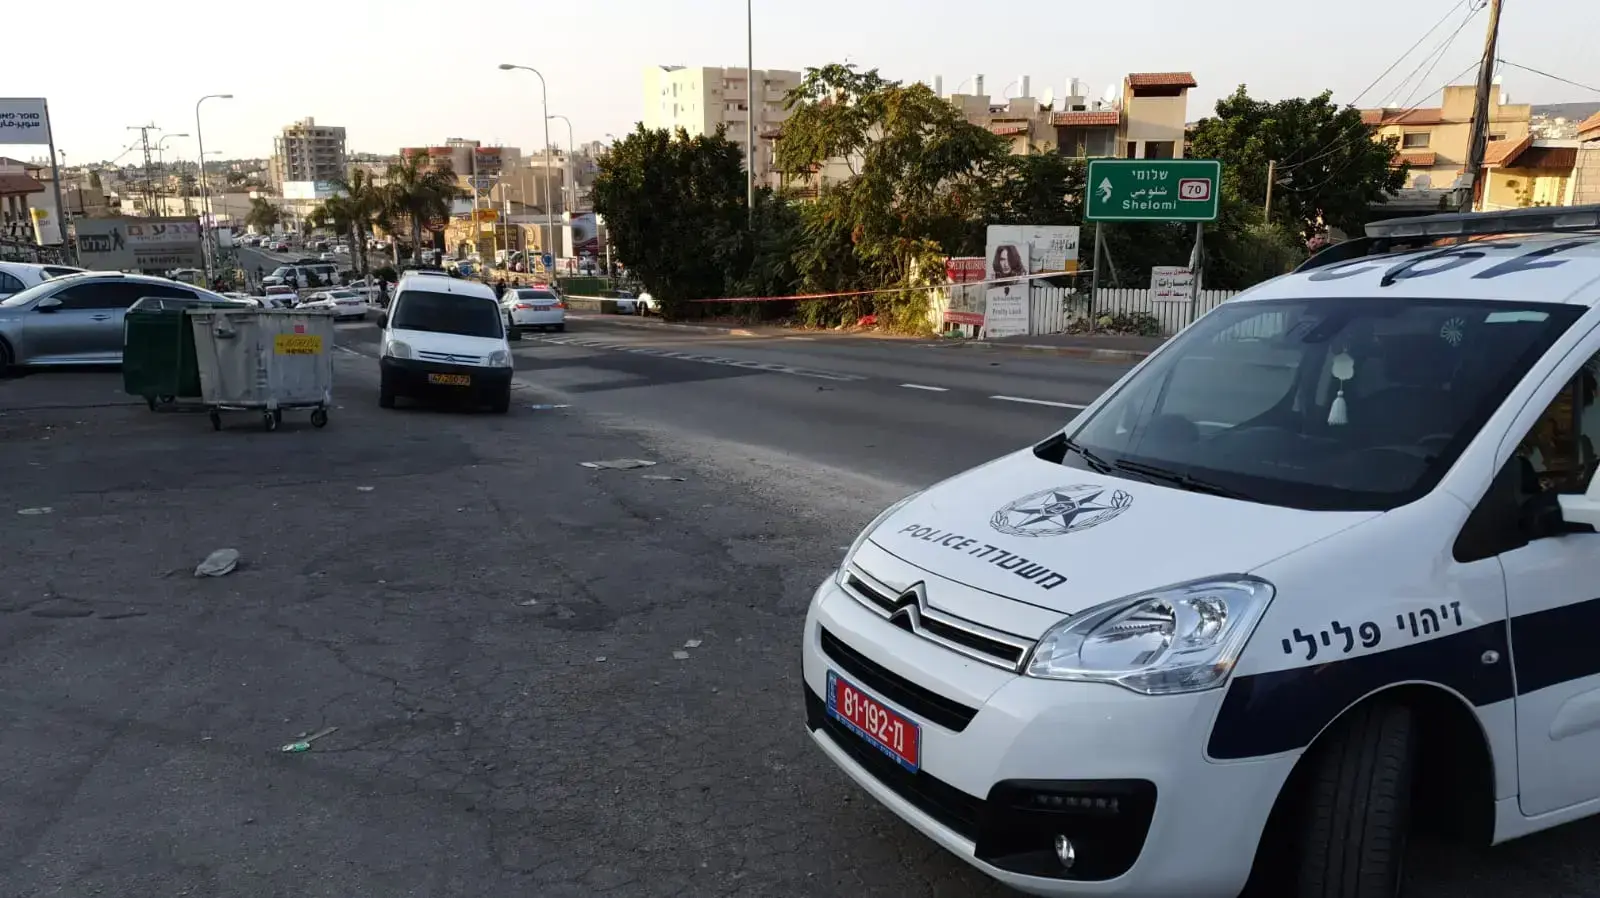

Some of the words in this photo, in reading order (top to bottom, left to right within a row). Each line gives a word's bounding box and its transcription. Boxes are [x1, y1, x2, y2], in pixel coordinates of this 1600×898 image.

[1132, 168, 1168, 180] שלומי
[1130, 185, 1168, 199] شلومي
[1187, 185, 1202, 195] 70
[1122, 199, 1177, 210] Shelomi
[898, 524, 978, 551] POLICE
[968, 544, 1068, 590] משטרה
[1396, 601, 1463, 637] זיהוי
[1281, 620, 1381, 661] פלילי
